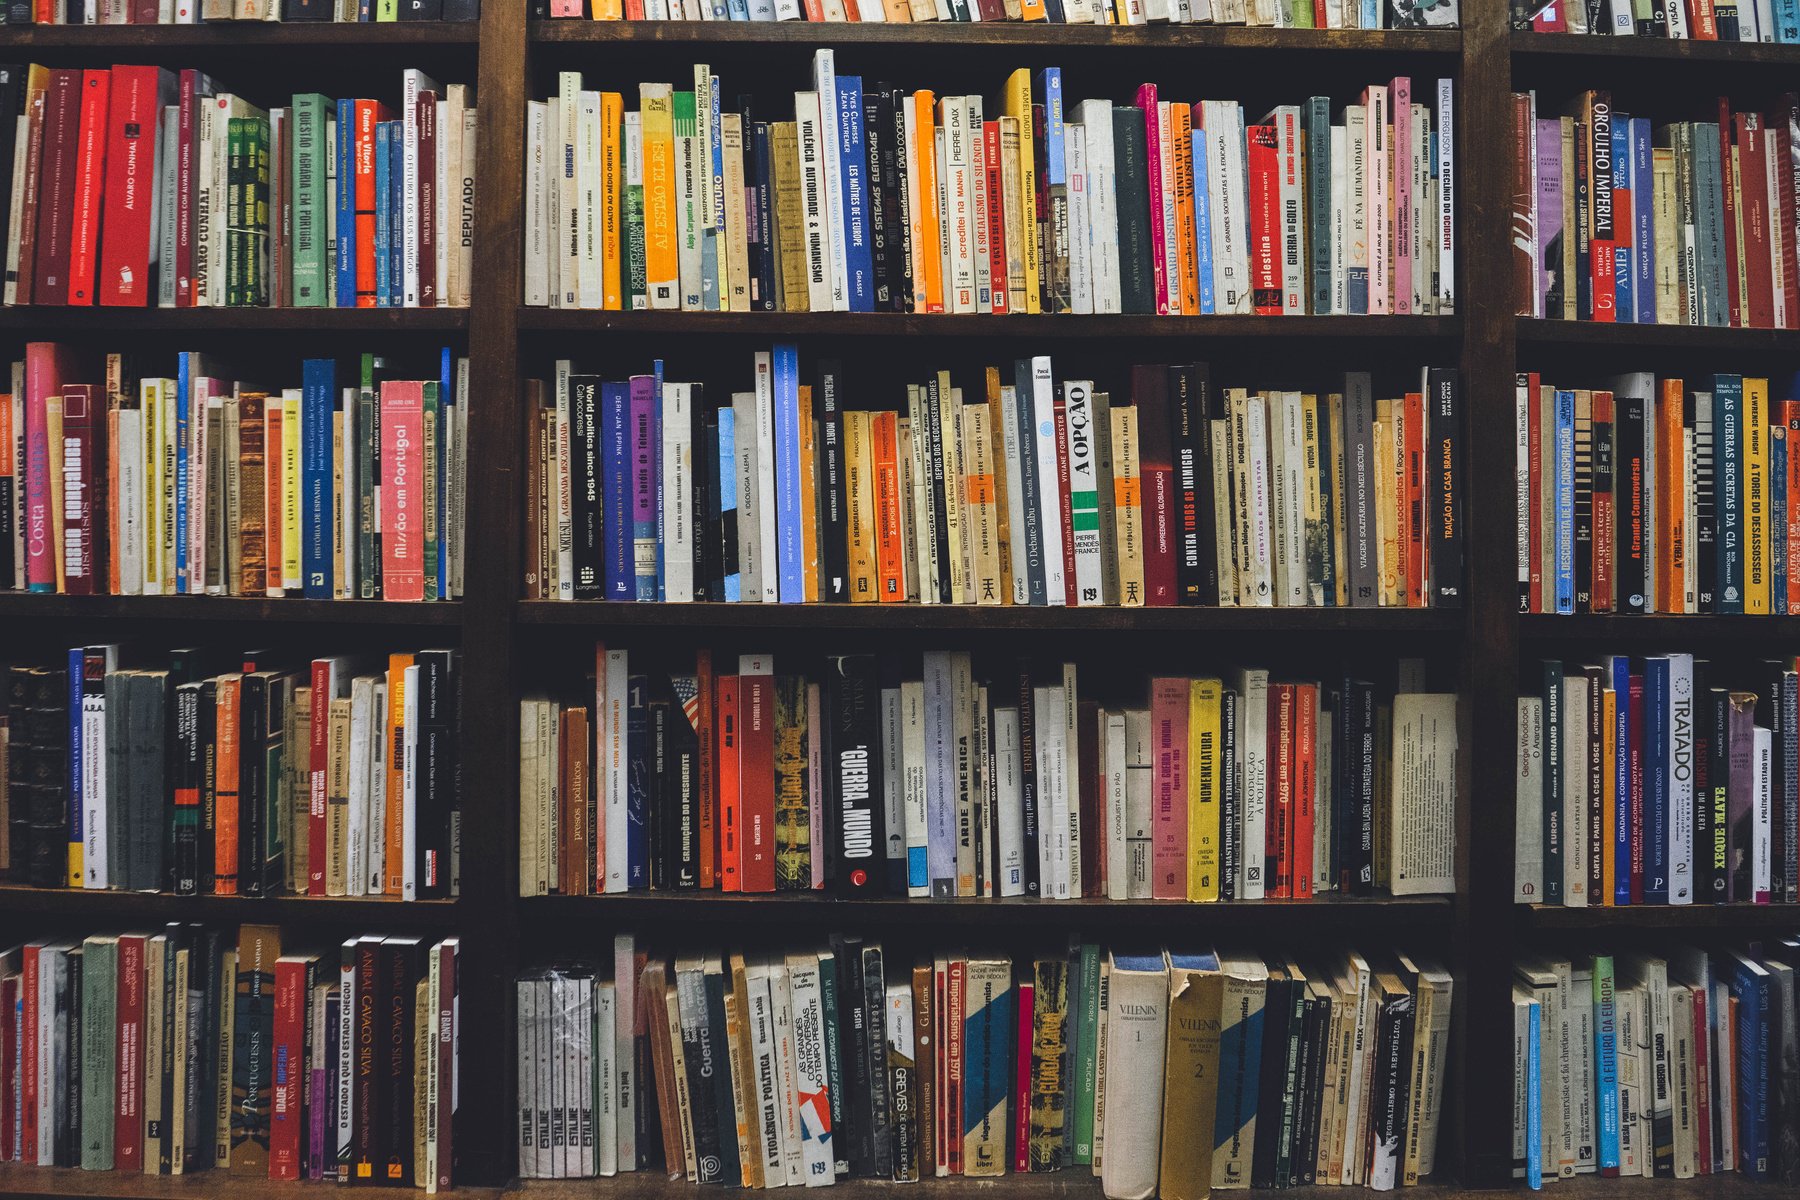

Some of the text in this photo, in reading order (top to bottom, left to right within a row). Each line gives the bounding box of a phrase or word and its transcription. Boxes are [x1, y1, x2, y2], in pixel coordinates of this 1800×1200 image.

[299, 111, 311, 148] QUESTÃO
[363, 108, 371, 132] Rumo
[802, 120, 815, 162] VIOLÊNCIA
[952, 108, 961, 161] PIERRE DAIX
[126, 141, 137, 209] ÁLVARO CUNHAL
[299, 153, 311, 188] AGRÁRIA
[566, 144, 574, 178] CHOMSKY
[652, 140, 666, 182] ELES!
[1594, 103, 1611, 232] ORGULHO IMPERIAL
[299, 193, 311, 205] EM
[605, 173, 613, 194] MÉDIO
[607, 196, 613, 205] AO
[806, 167, 817, 217] AUTORIDADE
[870, 131, 883, 248] OS SISTEMAS ELEITORAIS
[1353, 138, 1363, 230] FÉ NA HUMANIDADE
[462, 177, 473, 247] DEPUTADO
[652, 186, 667, 228] ESTÃO
[299, 210, 311, 251] PORTUGAL
[811, 233, 822, 283] HUMANISMO
[1262, 236, 1273, 287] palestina
[576, 384, 584, 436] Calvocoressi
[586, 385, 594, 411] World
[586, 414, 595, 449] politics
[929, 380, 942, 480] DEPOIS DOS NEOCONSERVADORES
[1069, 387, 1090, 475] A OPÇÃO
[394, 425, 409, 485] Portugal
[1724, 398, 1736, 548] AS GUERRAS SECRETAS DA CIA
[397, 489, 406, 509] em
[587, 478, 595, 501] 1945
[1443, 438, 1454, 539] TRAIÇÃO NA CASA BRANCA
[1630, 458, 1640, 516] Controvérsia
[1751, 472, 1761, 500] TORRE
[315, 513, 321, 523] DE
[1181, 449, 1197, 567] CONTRA TODOS OS INIMIGOS
[1752, 502, 1761, 514] DO
[30, 504, 45, 556] Costa
[81, 502, 90, 576] DISCURSOS
[1632, 518, 1640, 551] Grande
[1752, 516, 1761, 584] DESASSOSSEGO
[1521, 705, 1530, 777] George Woodcock
[1533, 705, 1541, 749] Anarquismo
[1674, 698, 1691, 781] TRATADO
[682, 753, 690, 802] PRESIDENTE
[841, 749, 868, 800] GUERRA
[1201, 732, 1212, 802] NOMENKLATURA
[1247, 752, 1256, 822] INTRODUÇÃO
[1256, 759, 1264, 805] POLÍTICA
[1618, 748, 1627, 795] CONSTRUÇÃO
[682, 804, 689, 814] DO
[959, 736, 969, 847] ARDE AMERICA
[573, 808, 582, 840] presos
[843, 808, 872, 858] MUNDO
[1715, 787, 1725, 869] XEQUE-MATE
[343, 982, 351, 1016] CHEGOU
[361, 951, 373, 1075] ANÍBAL CAVACO SILVA
[1601, 976, 1612, 1017] EUROPA
[342, 1018, 351, 1050] ESTADO
[854, 1008, 863, 1029] BUSH
[1356, 1028, 1364, 1051] MARX
[1603, 1020, 1613, 1032] DA
[700, 1027, 713, 1077] Guerra
[809, 998, 823, 1088] DO TEMPO PRESENTE
[1602, 1035, 1615, 1073] FUTURO
[342, 1060, 351, 1077] QUE
[760, 1053, 773, 1101] POLÍTICA
[950, 1058, 959, 1080] 1970
[1656, 1033, 1666, 1100] HUMBERTO DELGADO
[341, 1087, 349, 1120] ESTADO
[896, 1068, 907, 1111] GREVES
[522, 1108, 532, 1146] ESTALINE
[540, 1111, 550, 1149] ESTALINE
[553, 1108, 563, 1146] ESTALINE
[568, 1108, 578, 1146] ESTALINE
[582, 1108, 592, 1147] ESTALINE
[764, 1104, 778, 1158] VIOLÊNCIA
[1562, 1122, 1571, 1150] analyse
